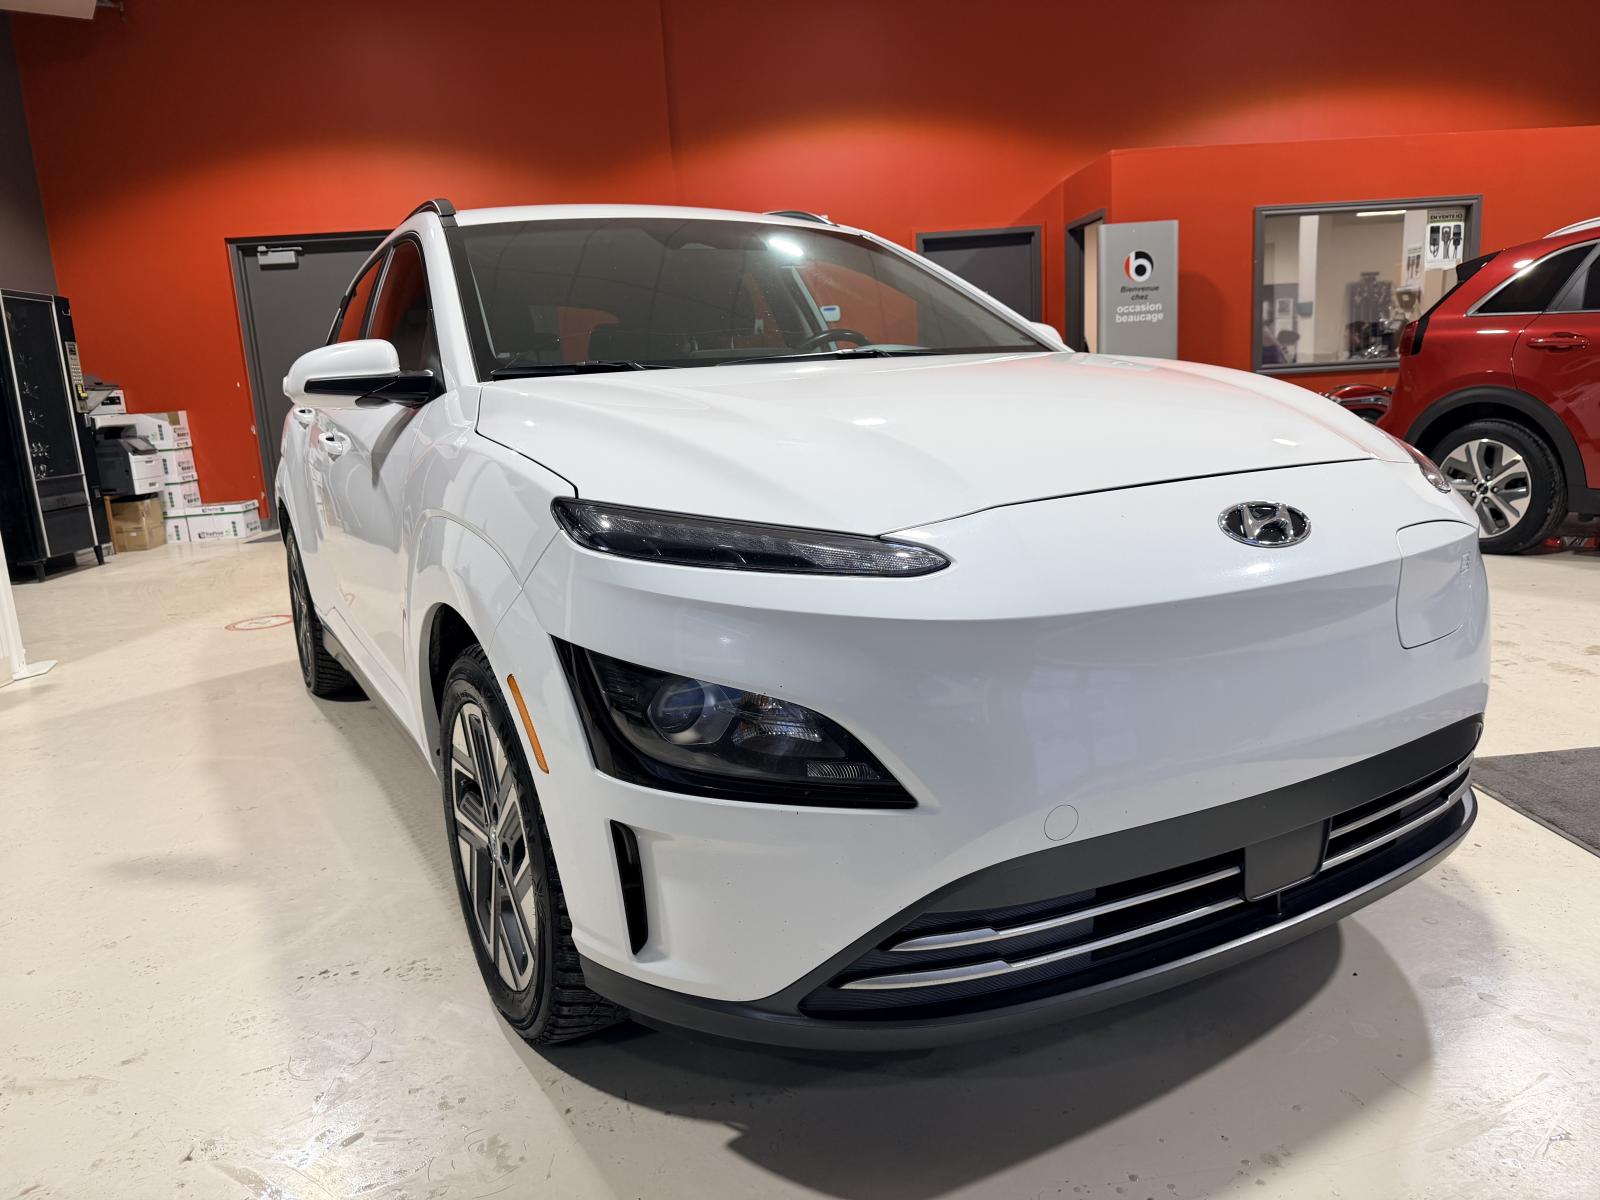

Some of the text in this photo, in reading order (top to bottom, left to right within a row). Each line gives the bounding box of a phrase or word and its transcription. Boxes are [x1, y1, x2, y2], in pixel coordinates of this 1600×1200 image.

[1120, 285, 1159, 293] Bienvenue
[1131, 293, 1149, 301] chez
[1117, 302, 1162, 313] occasion
[1115, 312, 1164, 323] beaucage
